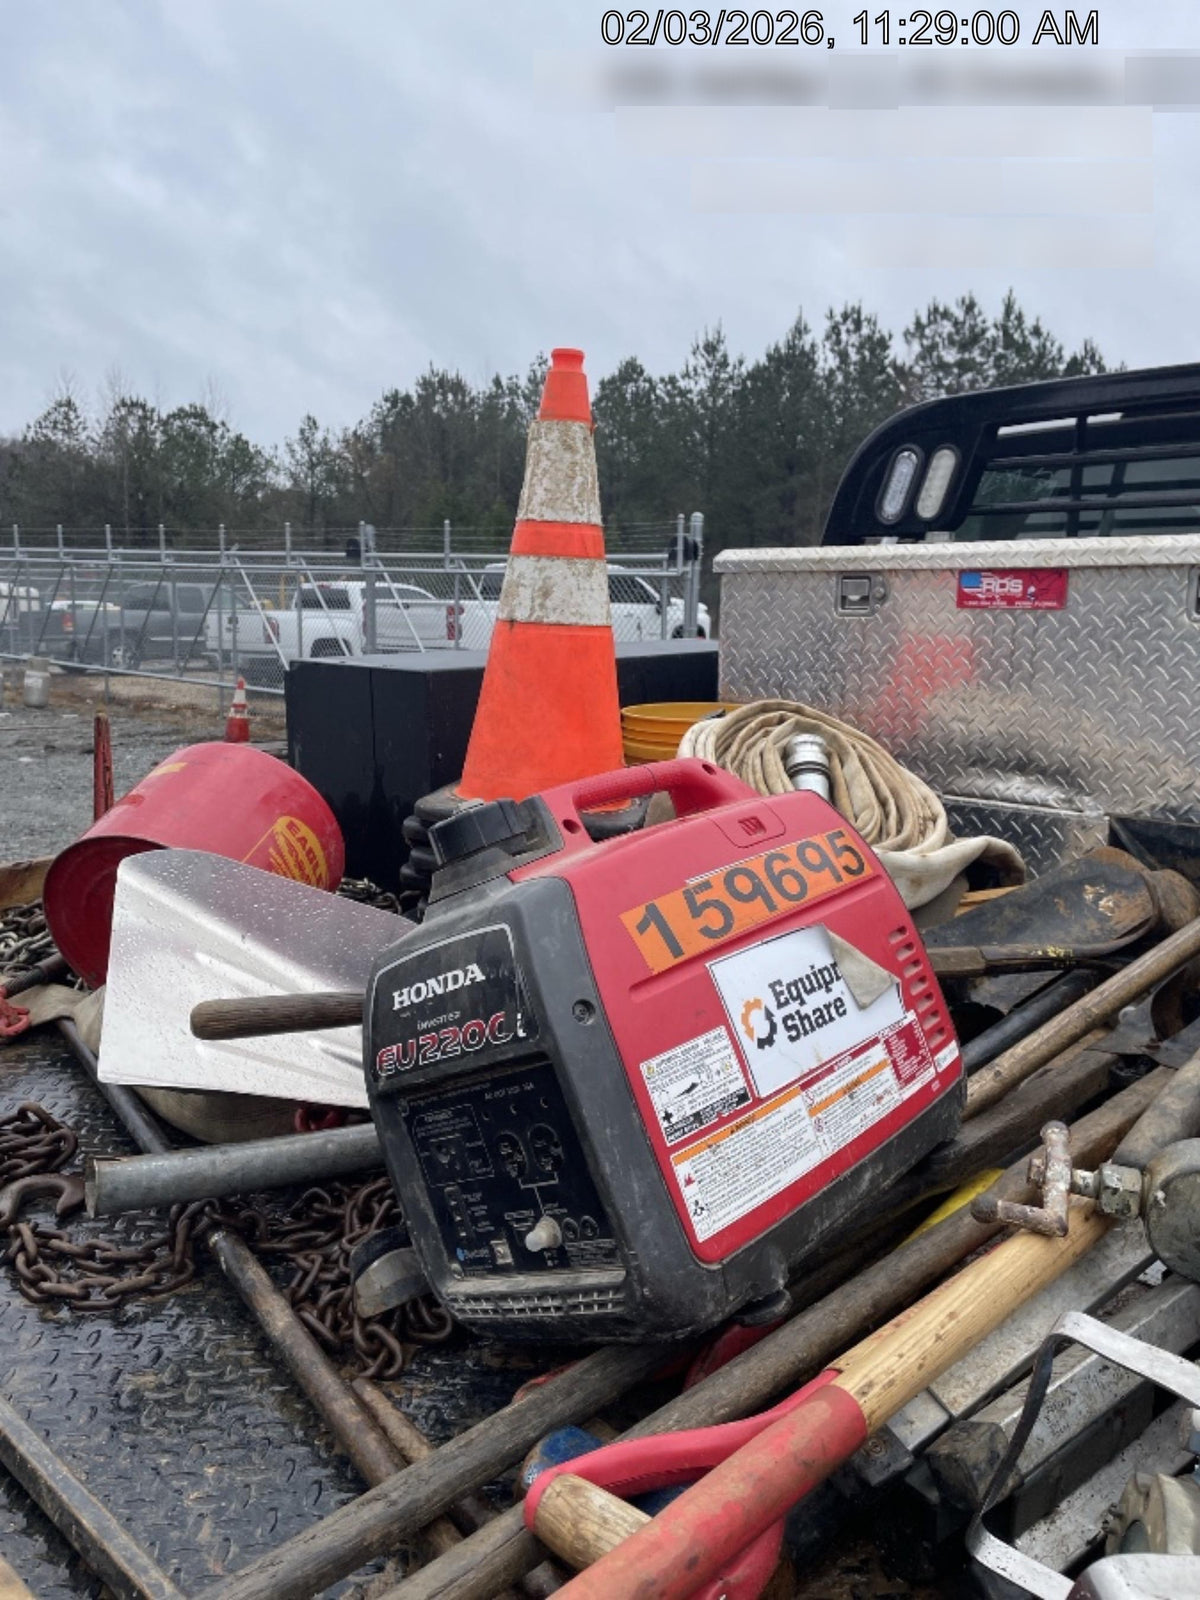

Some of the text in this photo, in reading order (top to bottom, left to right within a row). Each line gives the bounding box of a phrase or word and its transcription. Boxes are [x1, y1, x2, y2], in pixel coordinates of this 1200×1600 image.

[981, 579, 1023, 595] RDS
[636, 830, 865, 959] 159695
[392, 962, 486, 1010] HONDA
[768, 961, 842, 1010] Equip
[782, 996, 847, 1043] Share
